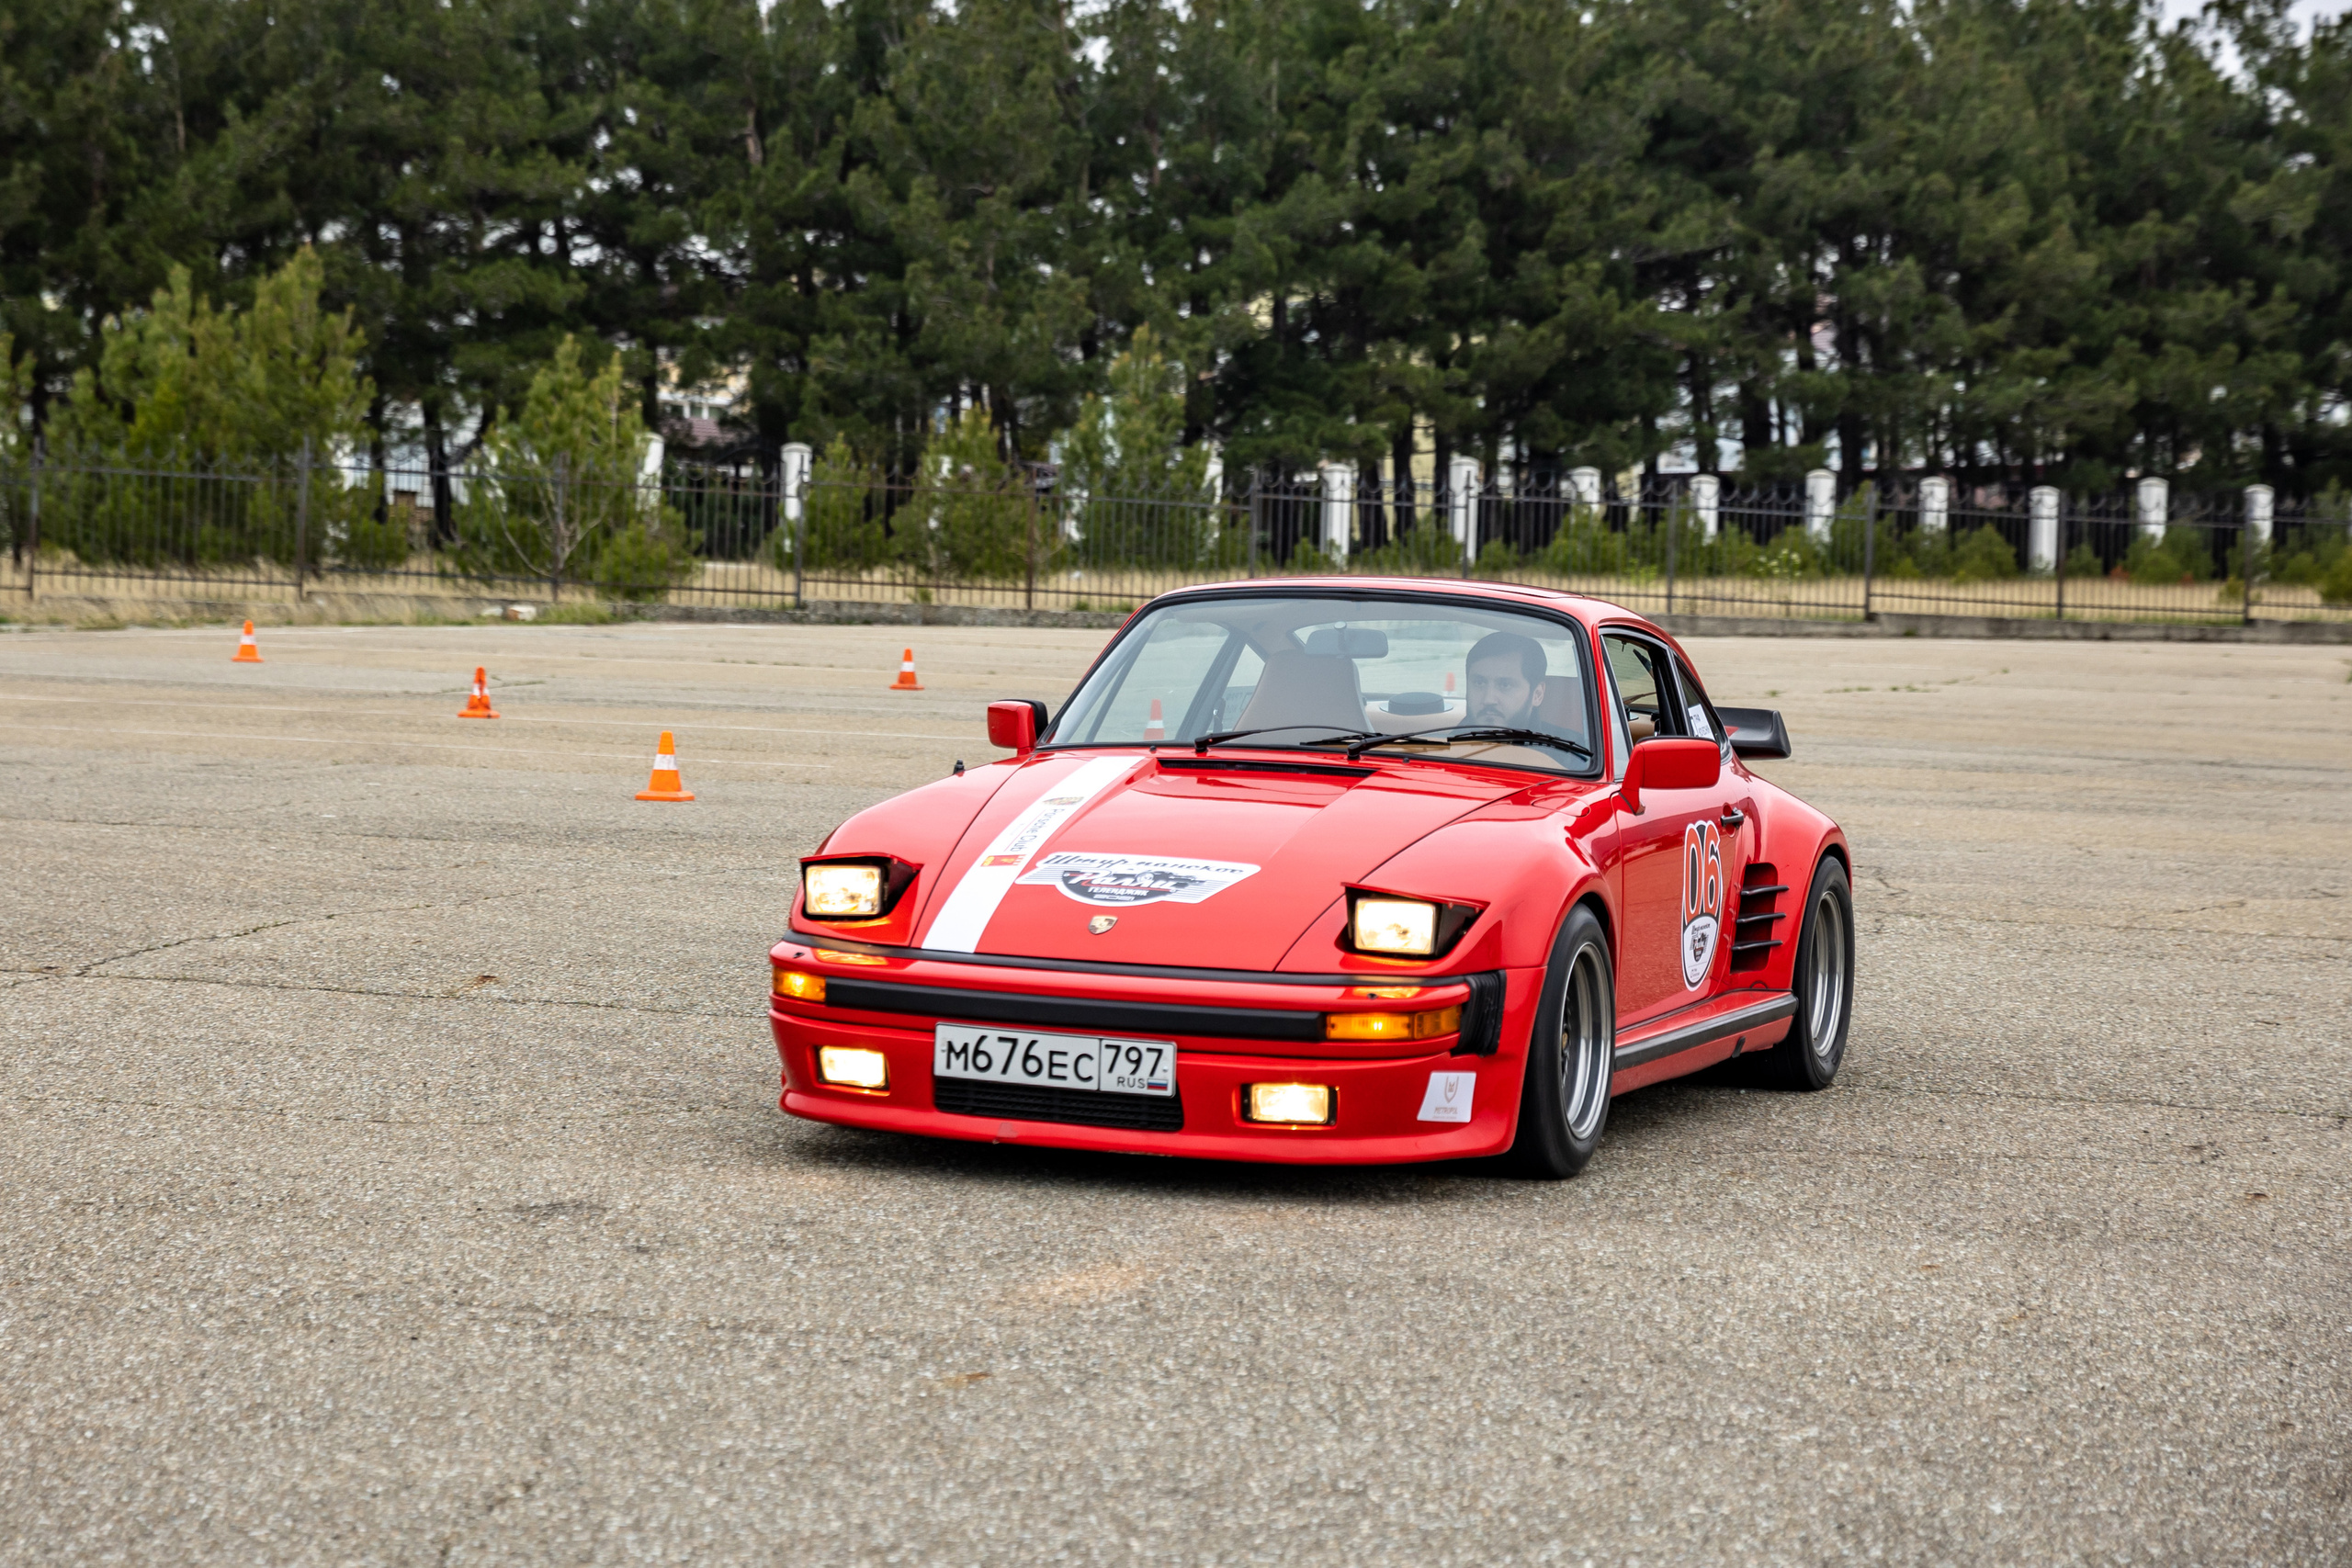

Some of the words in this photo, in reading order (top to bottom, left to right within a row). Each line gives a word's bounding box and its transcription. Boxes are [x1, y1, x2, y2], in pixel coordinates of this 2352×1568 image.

[1010, 835, 1037, 852] Club
[1685, 821, 1722, 924] 06
[1088, 886, 1149, 897] ГЕЛЕНДЖИК
[1104, 1044, 1164, 1077] 797
[1117, 1077, 1146, 1089] RUS
